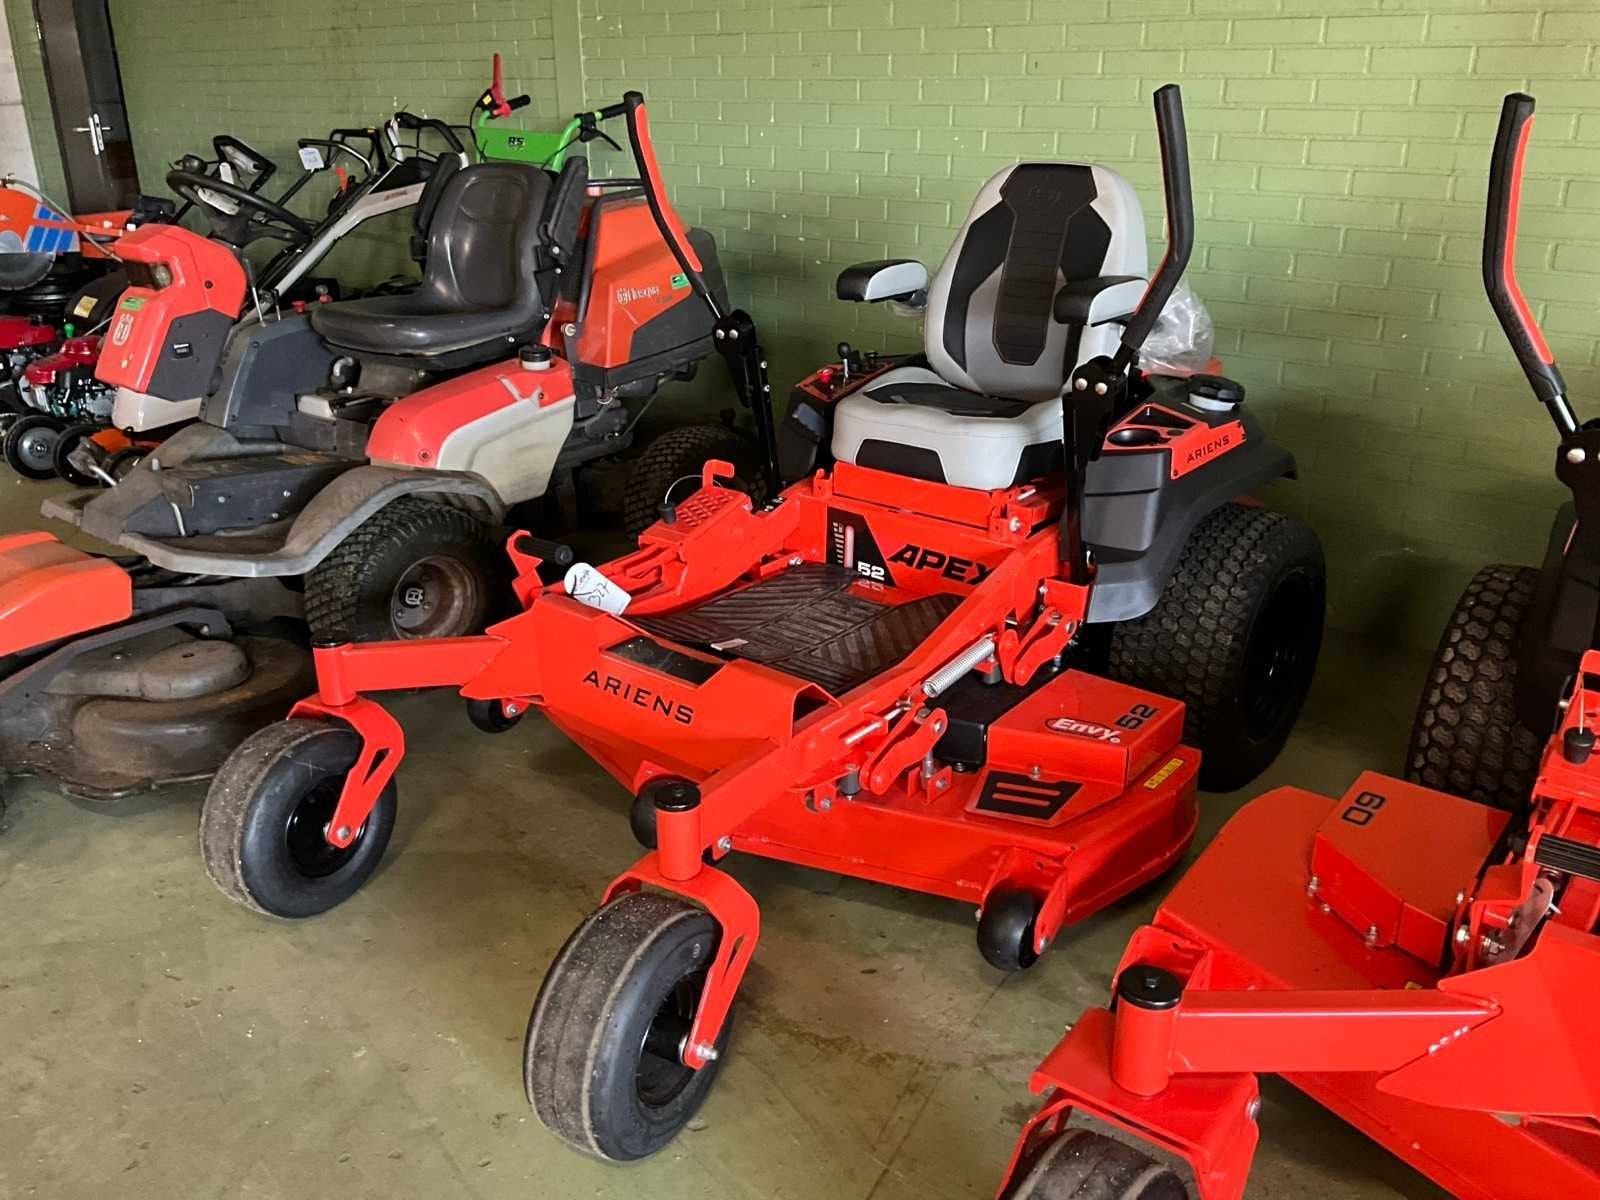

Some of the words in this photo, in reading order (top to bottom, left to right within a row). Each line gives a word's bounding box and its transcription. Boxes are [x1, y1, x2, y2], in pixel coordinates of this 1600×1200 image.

[1187, 435, 1230, 463] ARIENS
[857, 560, 885, 582] 52
[887, 543, 997, 586] APEX
[582, 670, 694, 725] ARIENS
[1051, 718, 1121, 741] Envy
[1115, 703, 1158, 730] 52
[1341, 791, 1386, 826] 60
